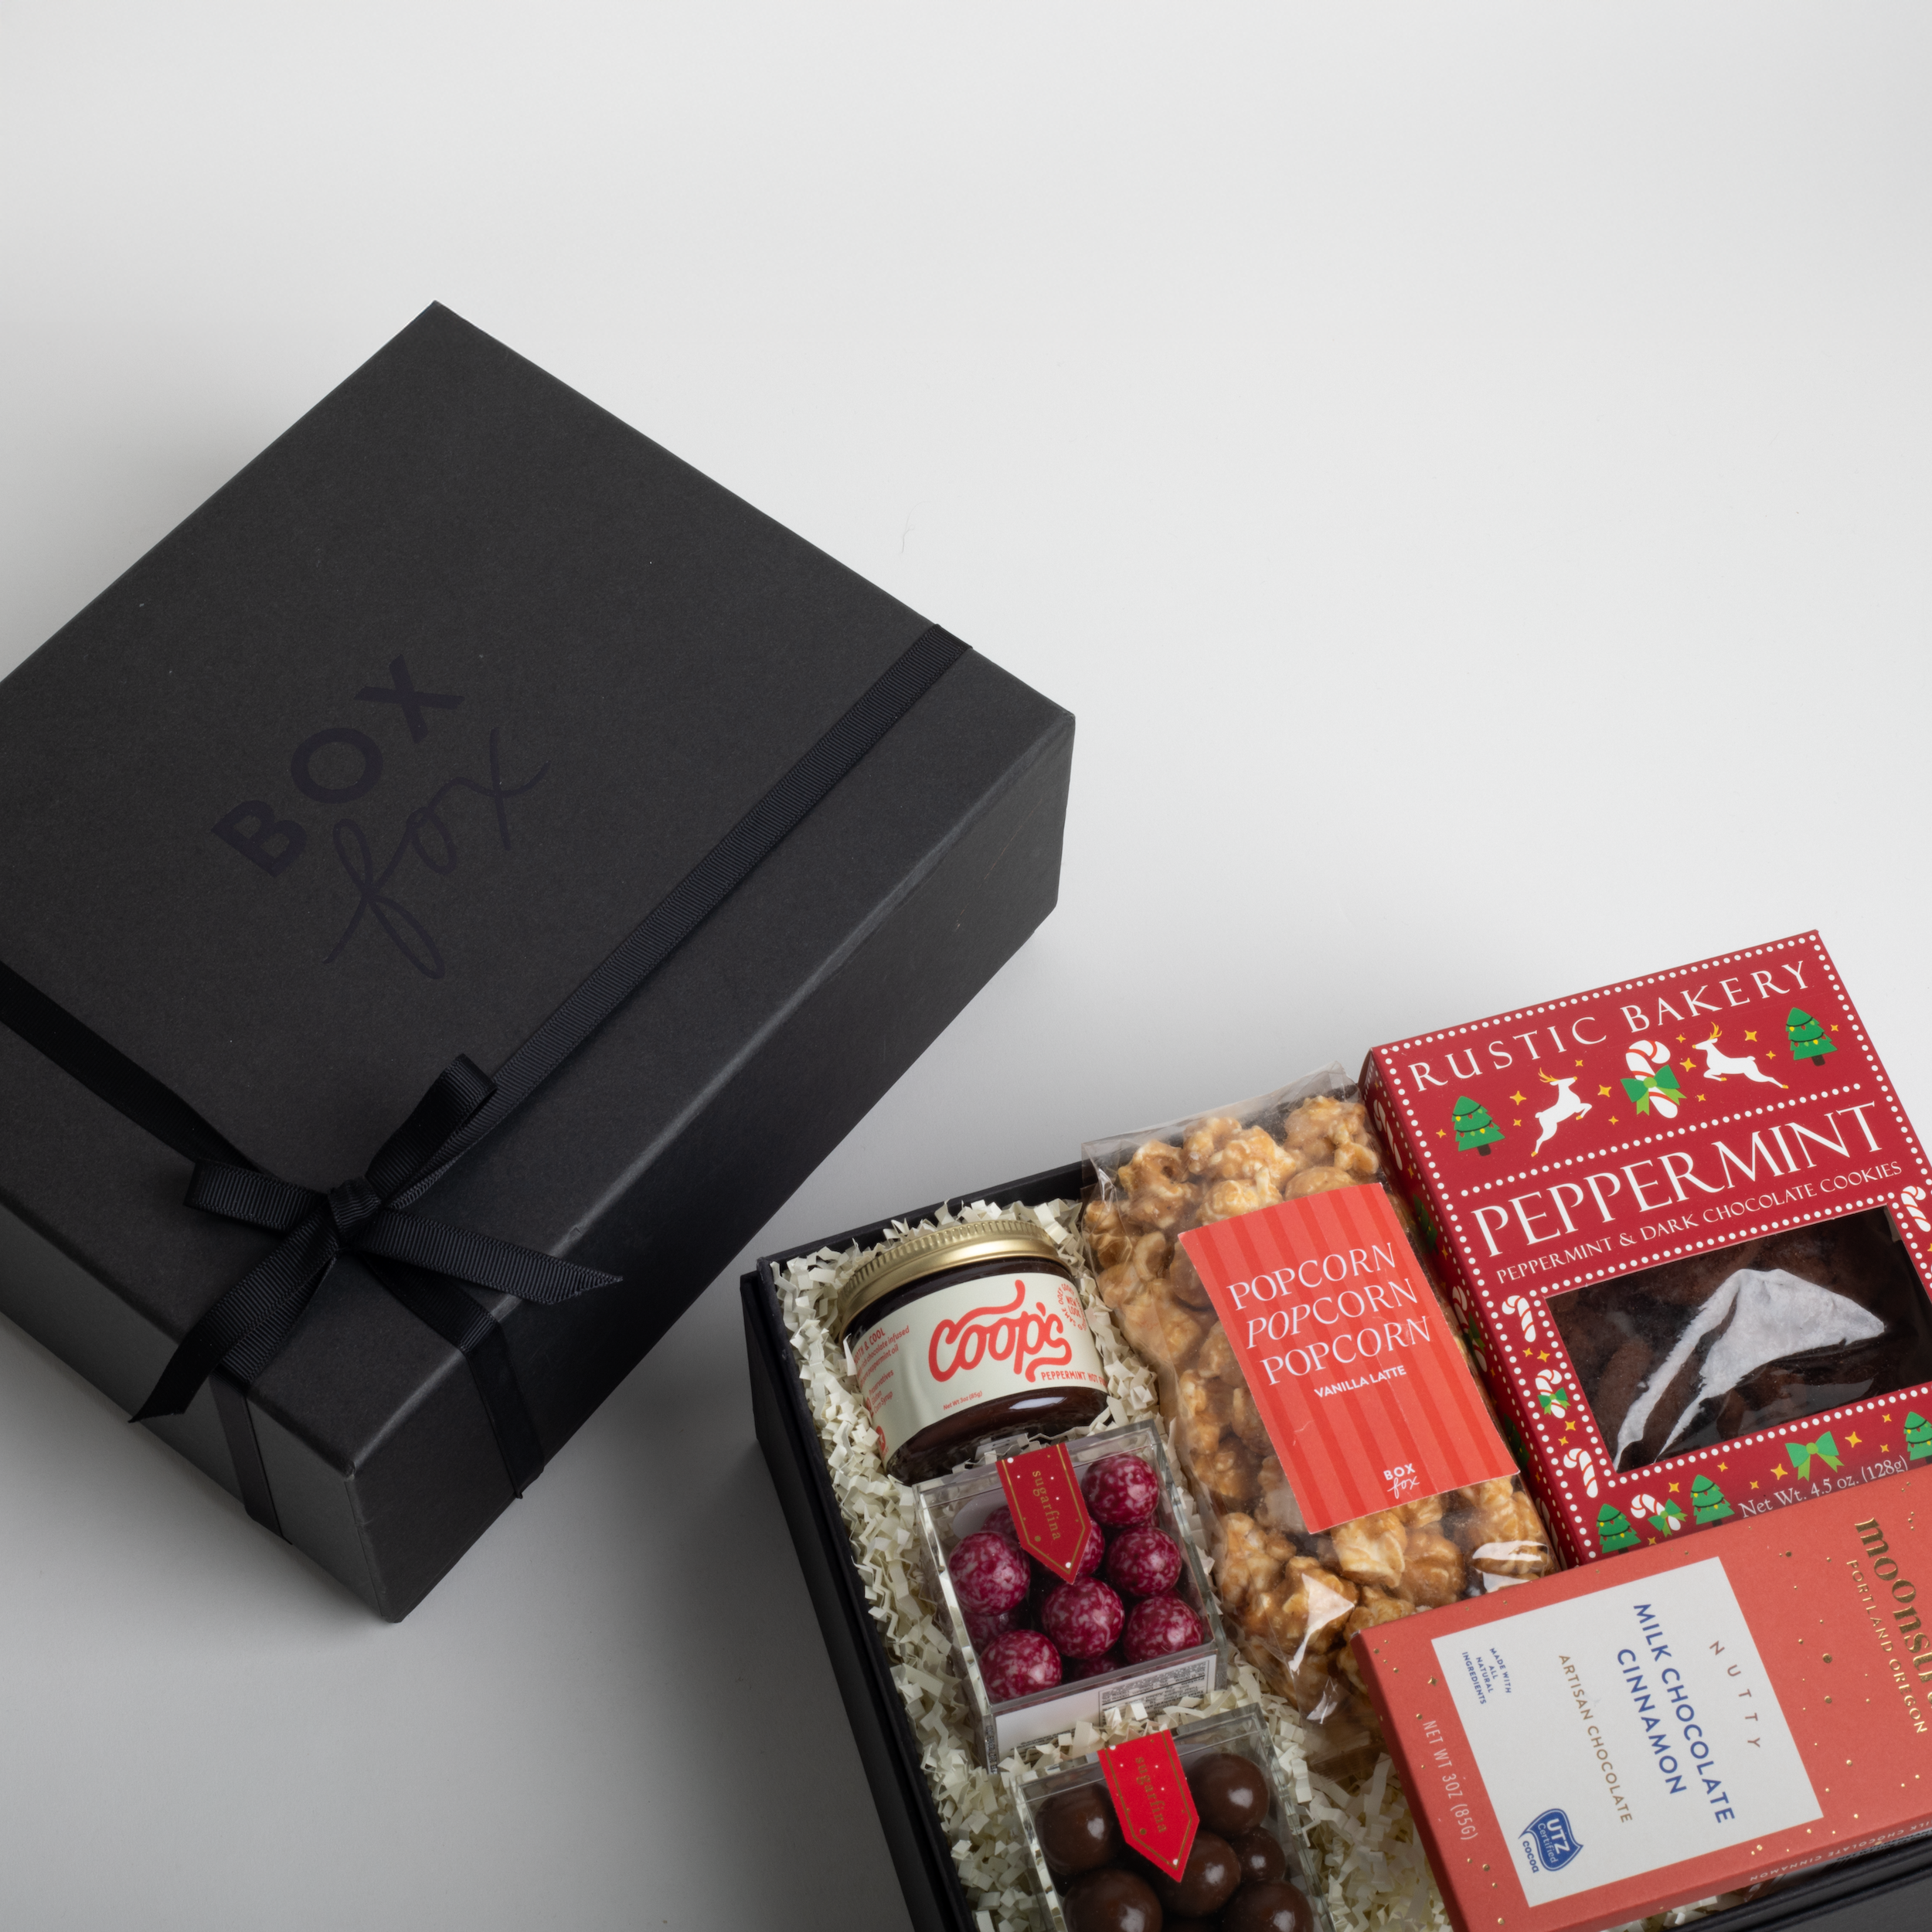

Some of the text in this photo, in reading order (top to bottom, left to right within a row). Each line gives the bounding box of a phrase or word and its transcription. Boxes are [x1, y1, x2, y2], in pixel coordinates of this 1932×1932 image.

[211, 654, 464, 877] BOX
[323, 726, 549, 979] fox
[1407, 961, 1809, 1092] RUSTIC BAKERY
[1471, 1100, 1882, 1257] PEPPERMINT
[1496, 1160, 1902, 1284] PEPPERMINT & DARK CHOCOLATE COOKIES
[1226, 1242, 1396, 1311] POPCORN
[1066, 1295, 1077, 1307] NEW
[1068, 1305, 1082, 1318] LOOK
[1246, 1278, 1418, 1349] POPCORN
[864, 1341, 869, 1351] &
[869, 1328, 886, 1345] COOL
[866, 1340, 888, 1362] chocolate
[887, 1325, 910, 1344] infused
[928, 1279, 1072, 1383] Coop's
[1260, 1315, 1430, 1386] POPCORN
[867, 1349, 891, 1376] peppermint
[1041, 1370, 1086, 1381] PEPPERMINT
[1087, 1372, 1098, 1383] HOT
[1314, 1365, 1406, 1398] VANILLA LATTE
[869, 1369, 894, 1396] Preservatives
[881, 1391, 893, 1406] Syrup
[968, 1390, 982, 1400] (85g)
[1383, 1463, 1415, 1481] BOX
[1387, 1477, 1420, 1499] fox
[1739, 1456, 1908, 1518] Net Wt. 4.5 oz. (128g)
[1032, 1470, 1061, 1541] sugarfina
[1845, 1559, 1929, 1734] PORTLAND OREGON
[1461, 1651, 1488, 1706] INGREDIENTS
[1475, 1656, 1495, 1694] NATURAL
[1488, 1665, 1499, 1681] ALL
[1489, 1647, 1512, 1694] MADE WITH
[1633, 1603, 1736, 1825] MILK CHOCOLATE
[1709, 1640, 1761, 1750] NUTTY
[1423, 1719, 1443, 1745] NET
[1558, 1653, 1633, 1825] ARTISAN CHOCOLATE
[1617, 1648, 1688, 1796] CINNAMON
[1432, 1747, 1452, 1770] WT
[1134, 1755, 1166, 1835] sugarfina
[1450, 1801, 1479, 1841] (85G)
[1545, 1818, 1570, 1854] UTZ
[1910, 1820, 1932, 1832] ILK
[1521, 1840, 1539, 1873] cocoa
[1536, 1821, 1560, 1864] Certified
[1828, 1829, 1904, 1857] CHOCOLATE
[1750, 1855, 1822, 1882] CINNAMON
